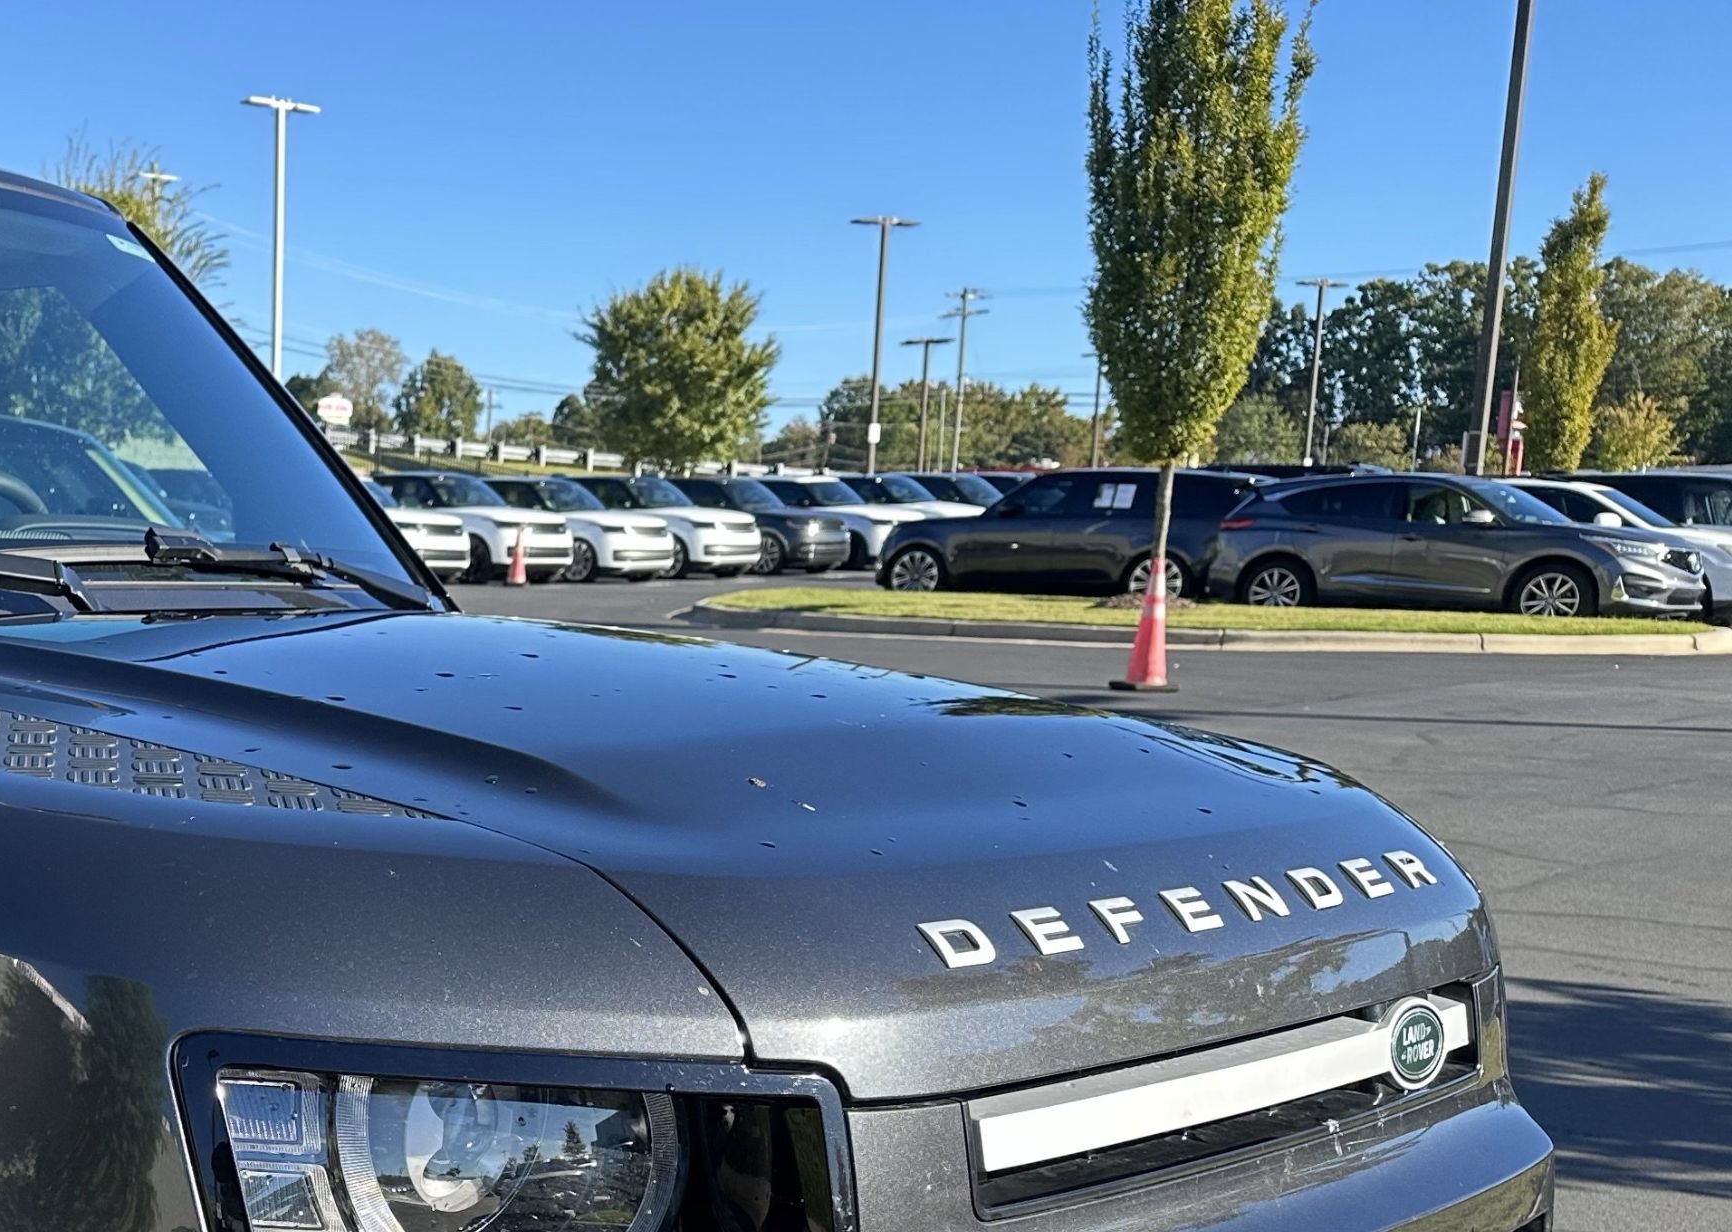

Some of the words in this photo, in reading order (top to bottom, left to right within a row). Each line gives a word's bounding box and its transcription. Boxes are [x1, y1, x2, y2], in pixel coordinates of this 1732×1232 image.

[916, 849, 1438, 969] DEFENDER
[1402, 1022, 1426, 1046] LAND
[1406, 1039, 1435, 1064] ROVER
